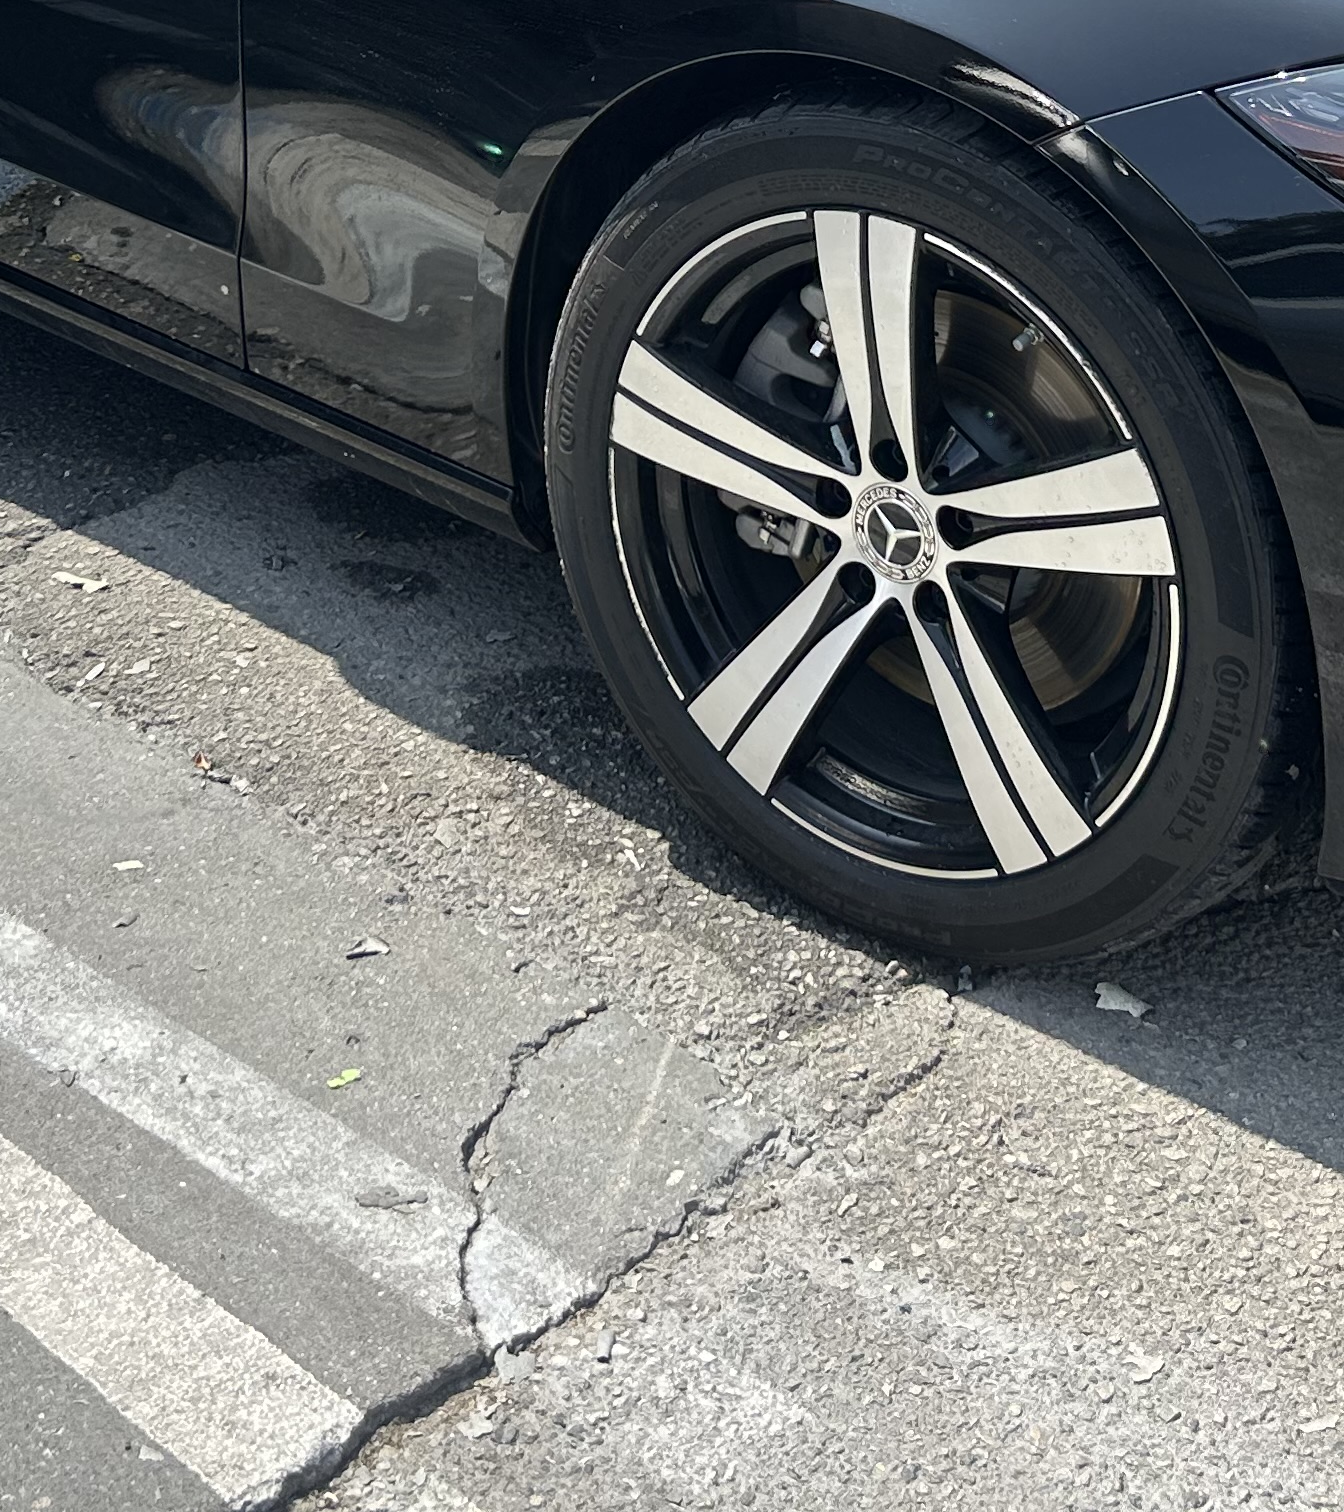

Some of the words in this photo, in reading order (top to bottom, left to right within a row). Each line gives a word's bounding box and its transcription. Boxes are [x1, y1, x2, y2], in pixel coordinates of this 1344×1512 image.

[855, 486, 898, 526] MERCEDES
[905, 555, 931, 578] BENZ
[1176, 654, 1251, 828] Continental
